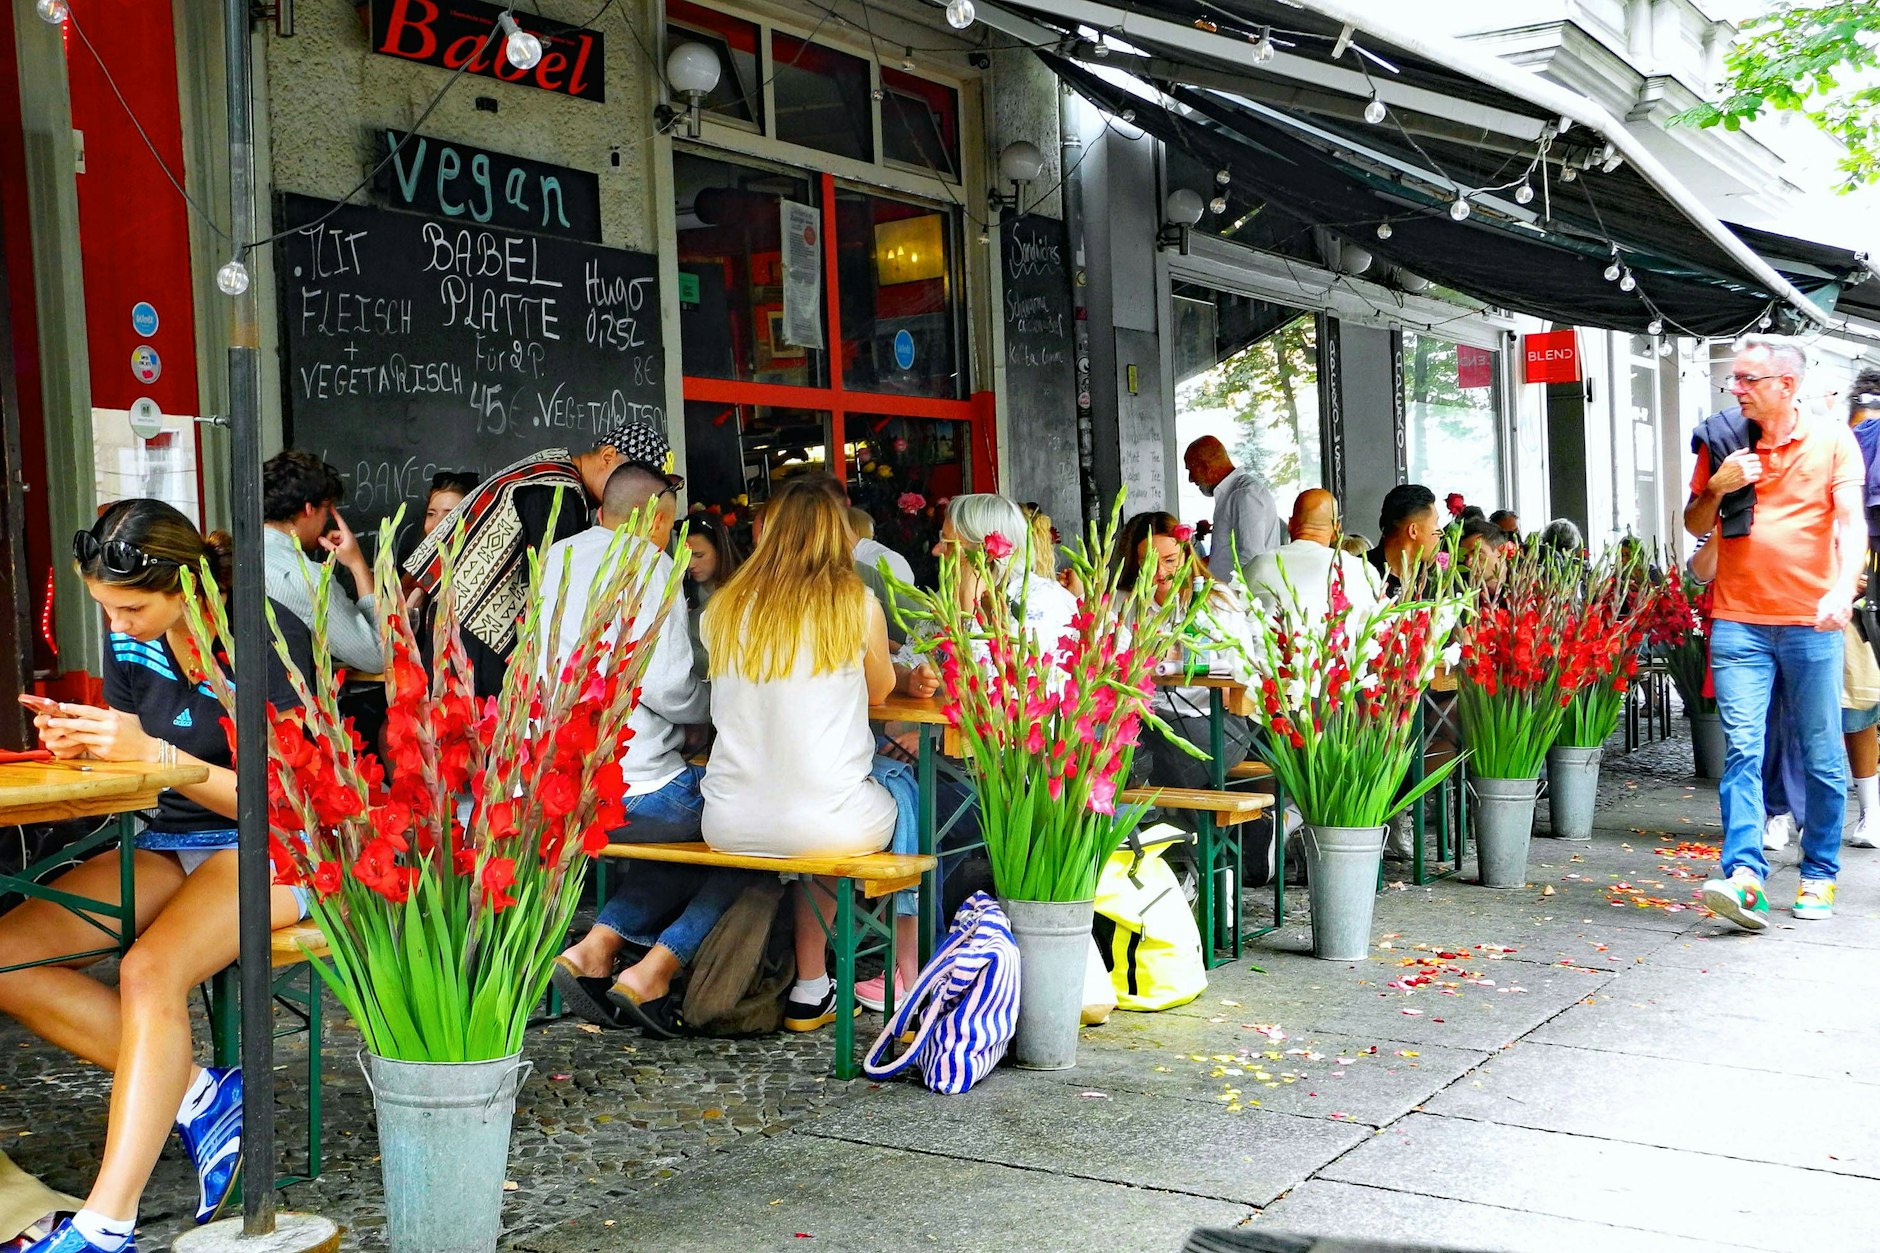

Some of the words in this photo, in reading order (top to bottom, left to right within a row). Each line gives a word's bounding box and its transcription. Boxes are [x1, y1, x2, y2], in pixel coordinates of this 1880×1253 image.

[387, 130, 570, 228] Vegan
[423, 222, 562, 287] BABEL
[441, 275, 560, 340] PLATTE
[585, 258, 653, 311] Hugo
[302, 286, 411, 336] FLEISCH
[301, 353, 463, 399] VEGETARISCH
[476, 332, 505, 372] Für
[1528, 349, 1573, 362] BLEND
